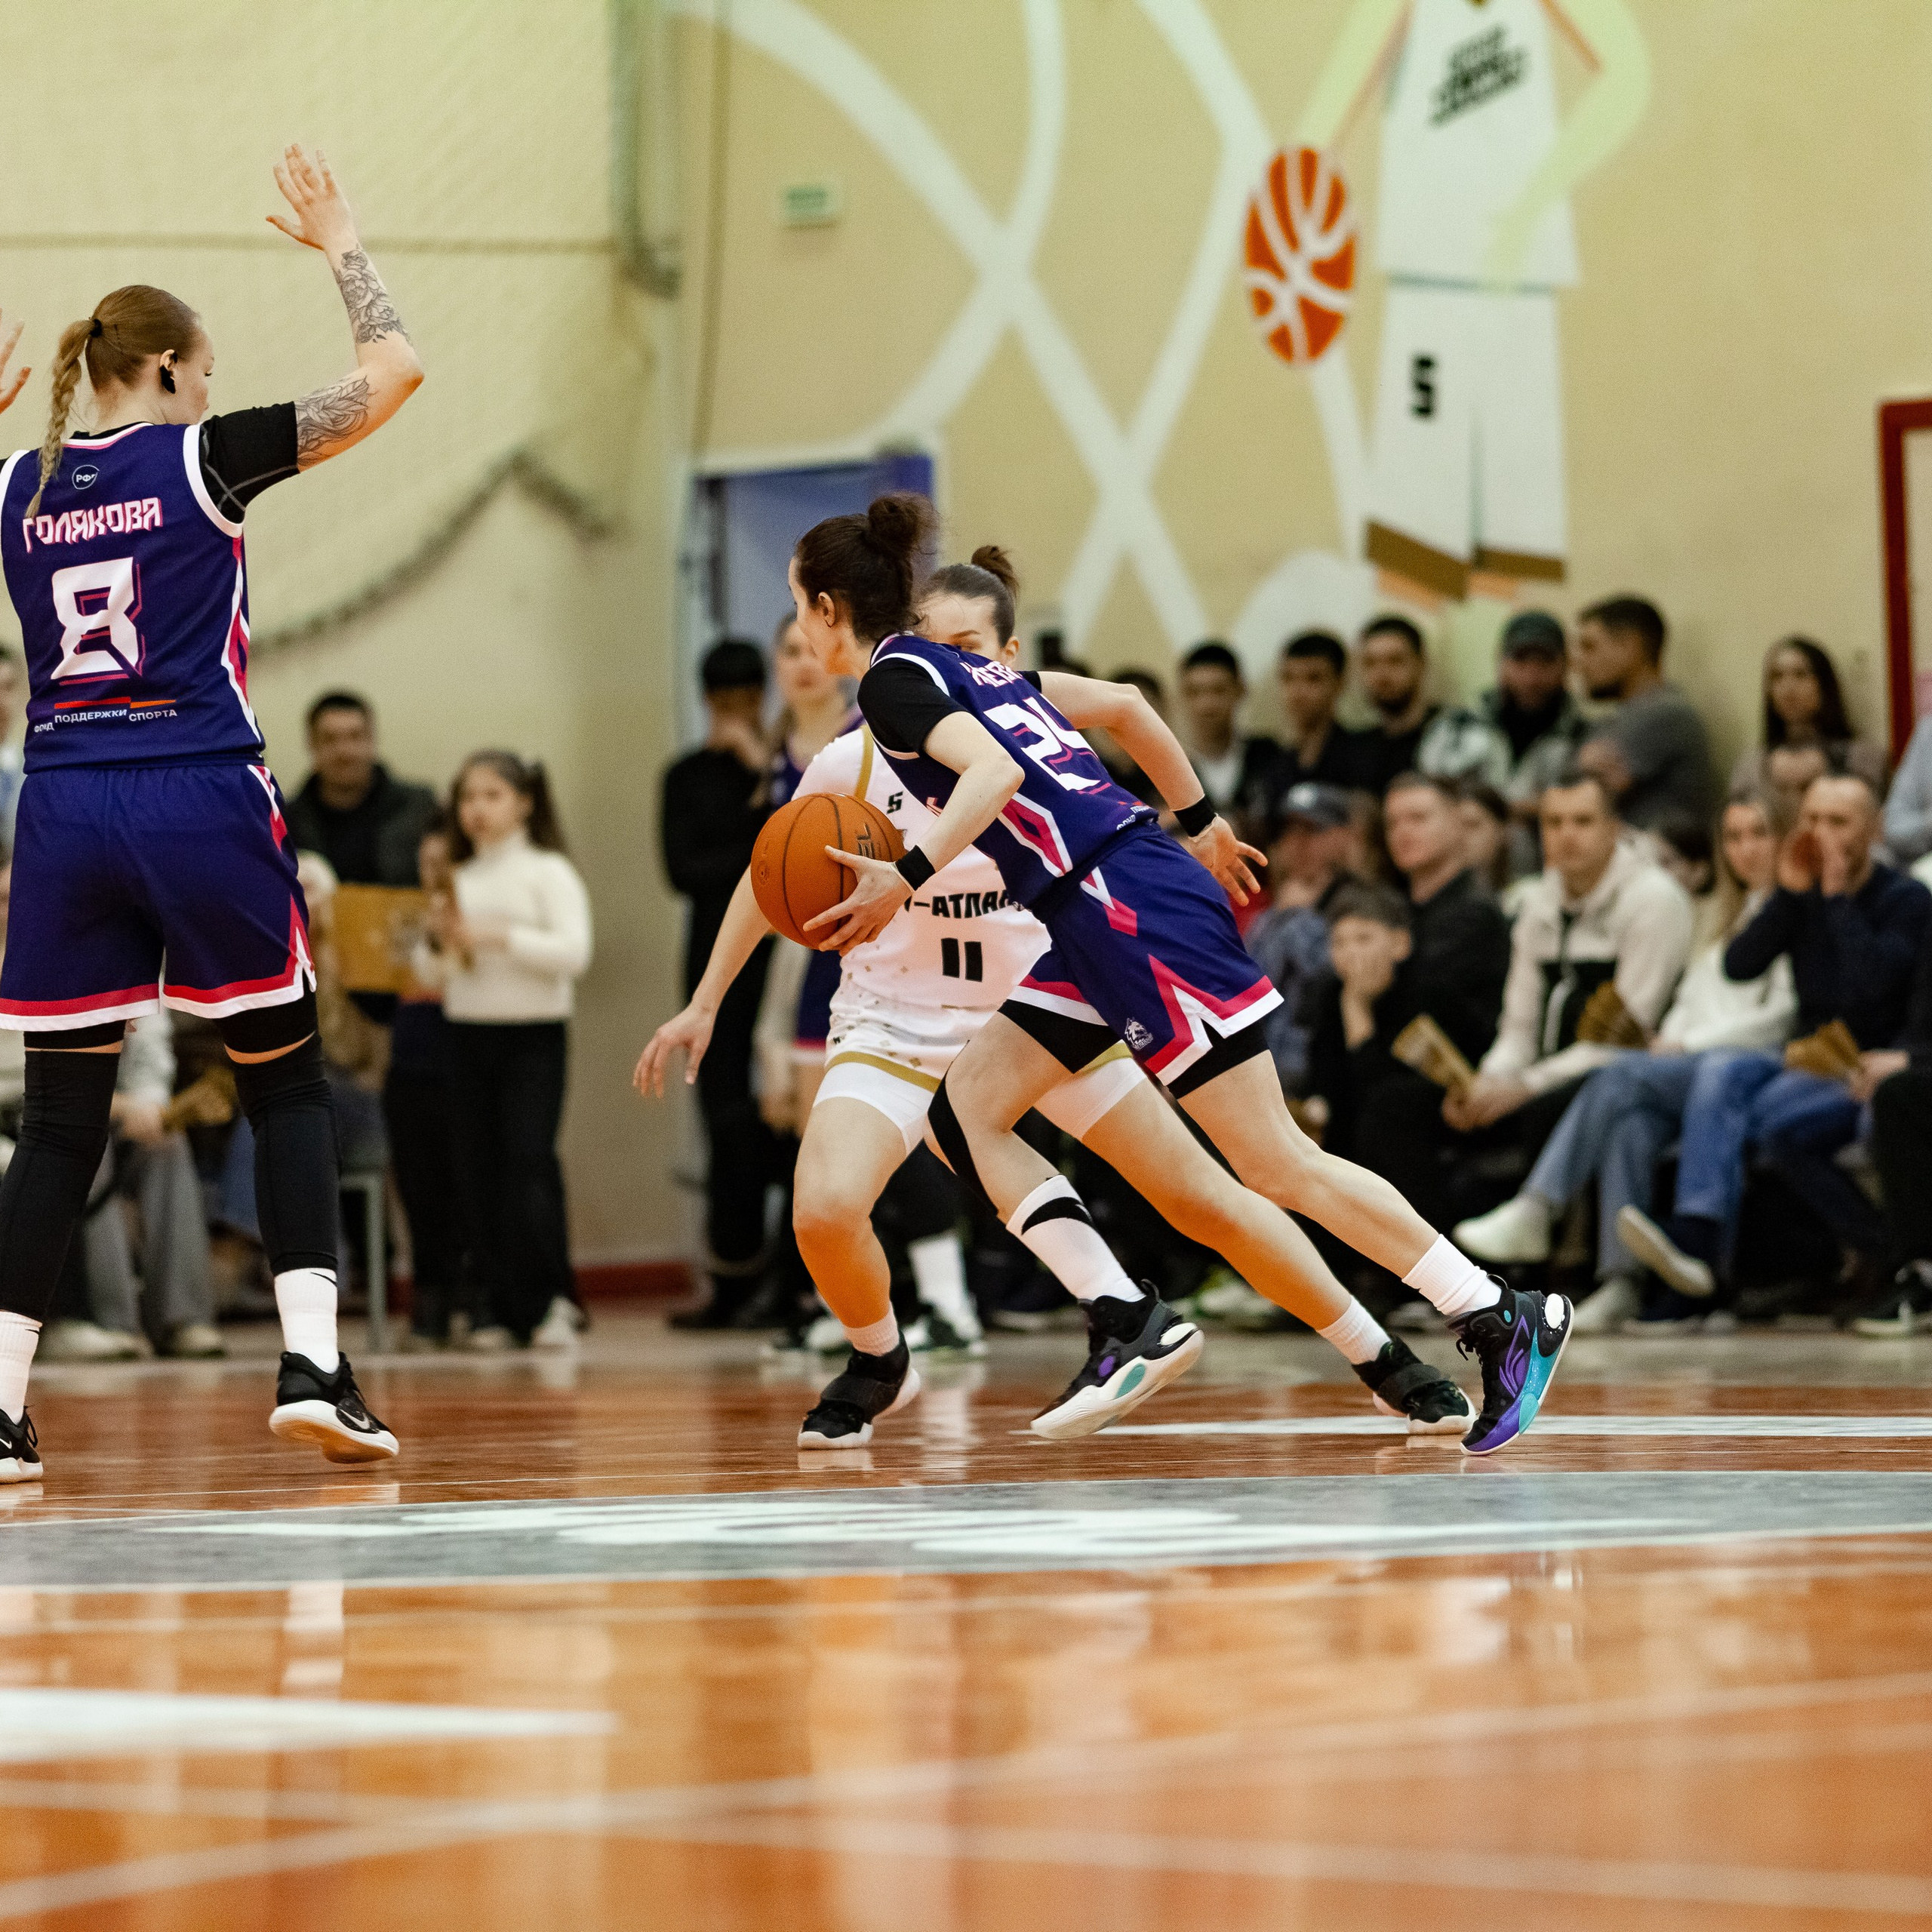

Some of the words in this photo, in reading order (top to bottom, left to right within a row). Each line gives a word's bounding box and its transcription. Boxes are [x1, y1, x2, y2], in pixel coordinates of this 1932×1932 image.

[22, 497, 163, 554] ГОЛЯКОВА
[51, 556, 142, 680] 8
[54, 709, 128, 724] ПОДДЕРЖКИ
[128, 709, 177, 722] СПОРТА
[940, 937, 983, 983] 11
